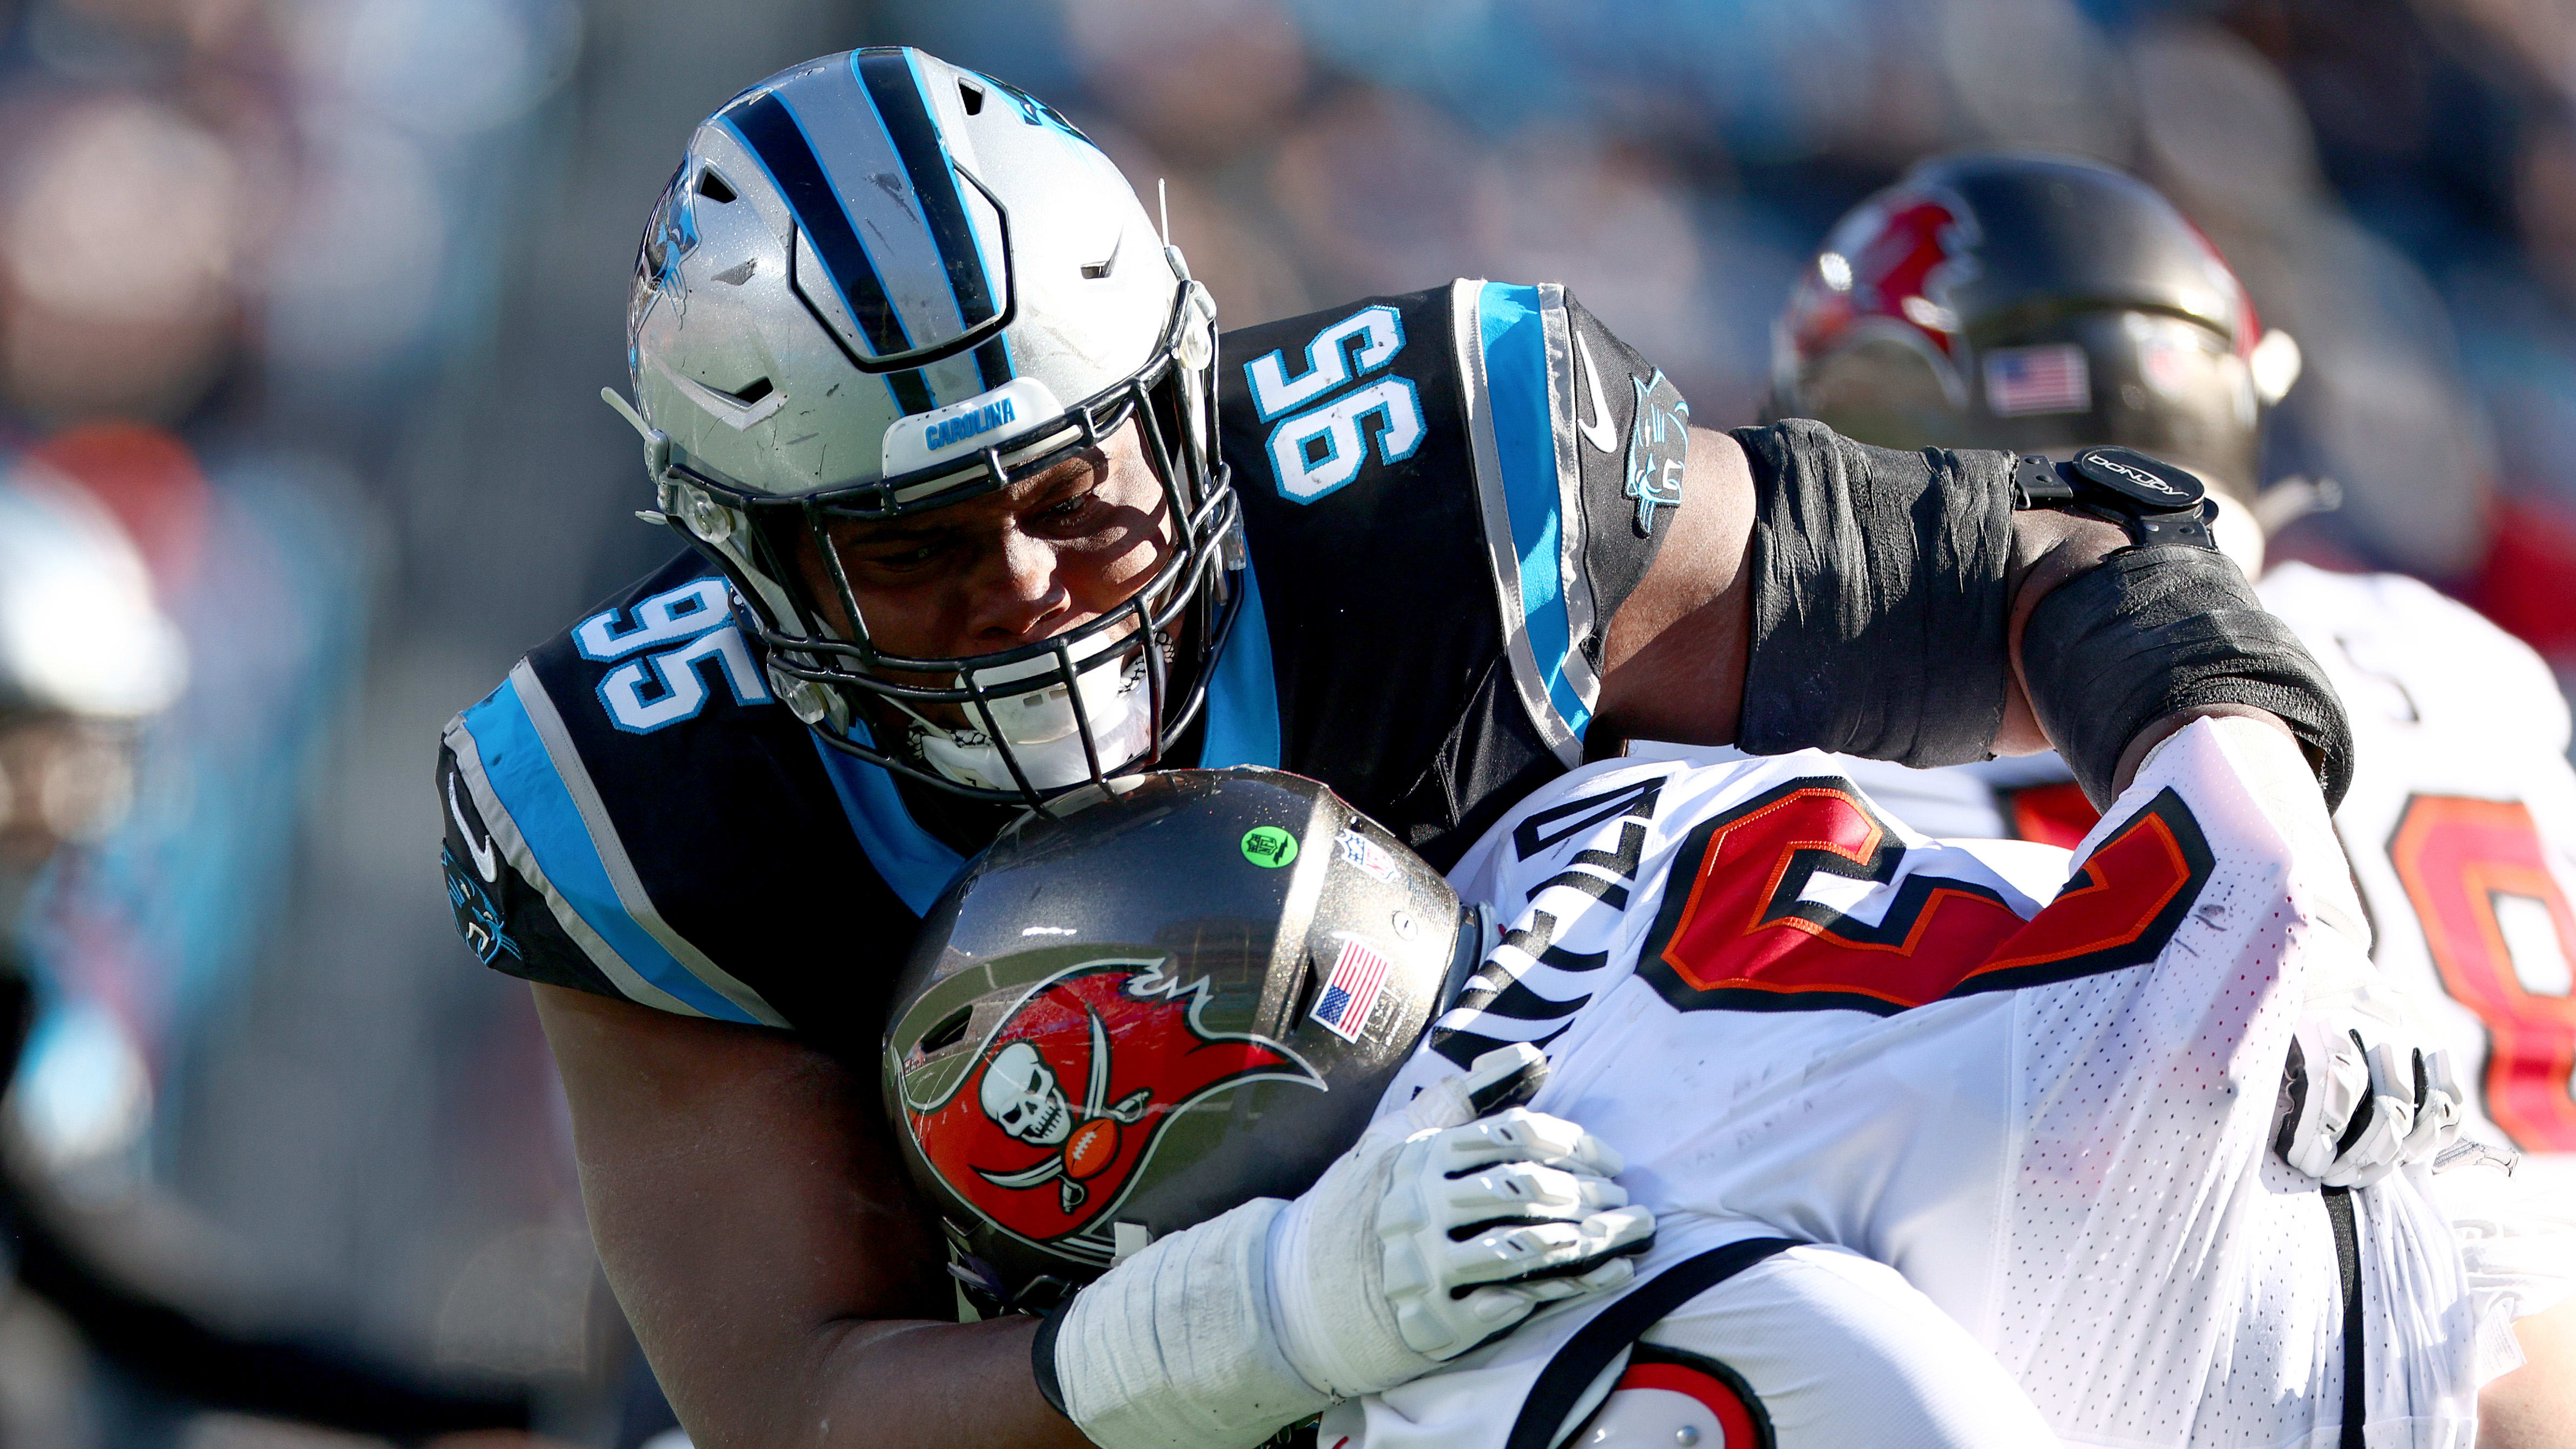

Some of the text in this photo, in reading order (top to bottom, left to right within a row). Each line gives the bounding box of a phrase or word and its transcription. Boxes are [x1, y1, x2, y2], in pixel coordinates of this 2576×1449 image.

[925, 397, 1016, 451] CAROLINA
[1243, 304, 1428, 505] 95
[2088, 454, 2189, 497] DONJOY
[571, 577, 774, 735] 95
